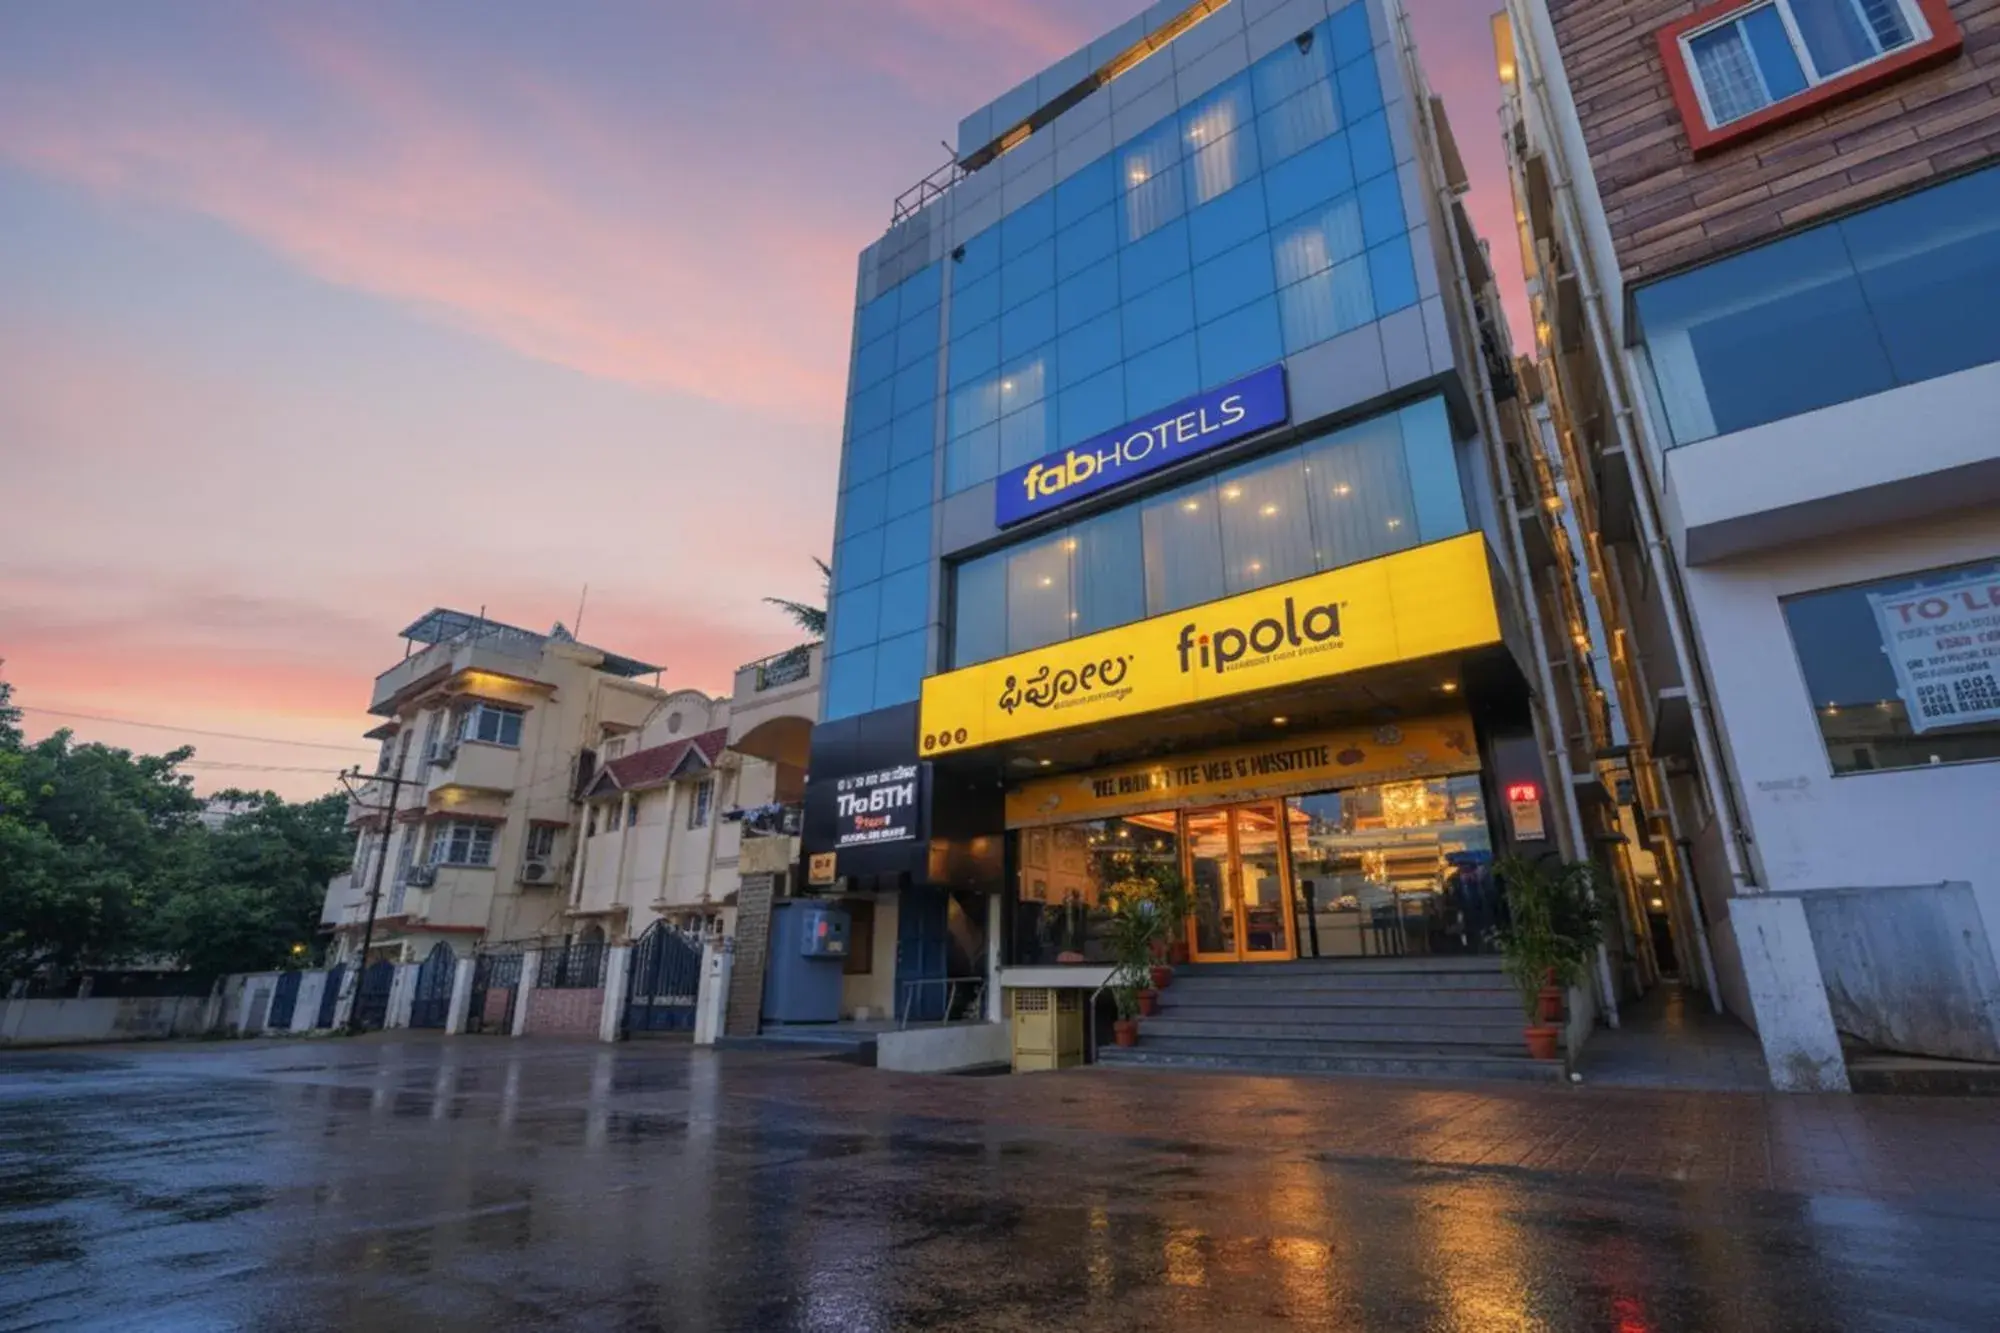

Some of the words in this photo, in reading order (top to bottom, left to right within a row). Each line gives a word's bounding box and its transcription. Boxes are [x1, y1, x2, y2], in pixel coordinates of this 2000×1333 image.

[1024, 395, 1246, 501] fabHOTELS
[1177, 597, 1341, 673] fipola
[1887, 597, 1951, 626] TO
